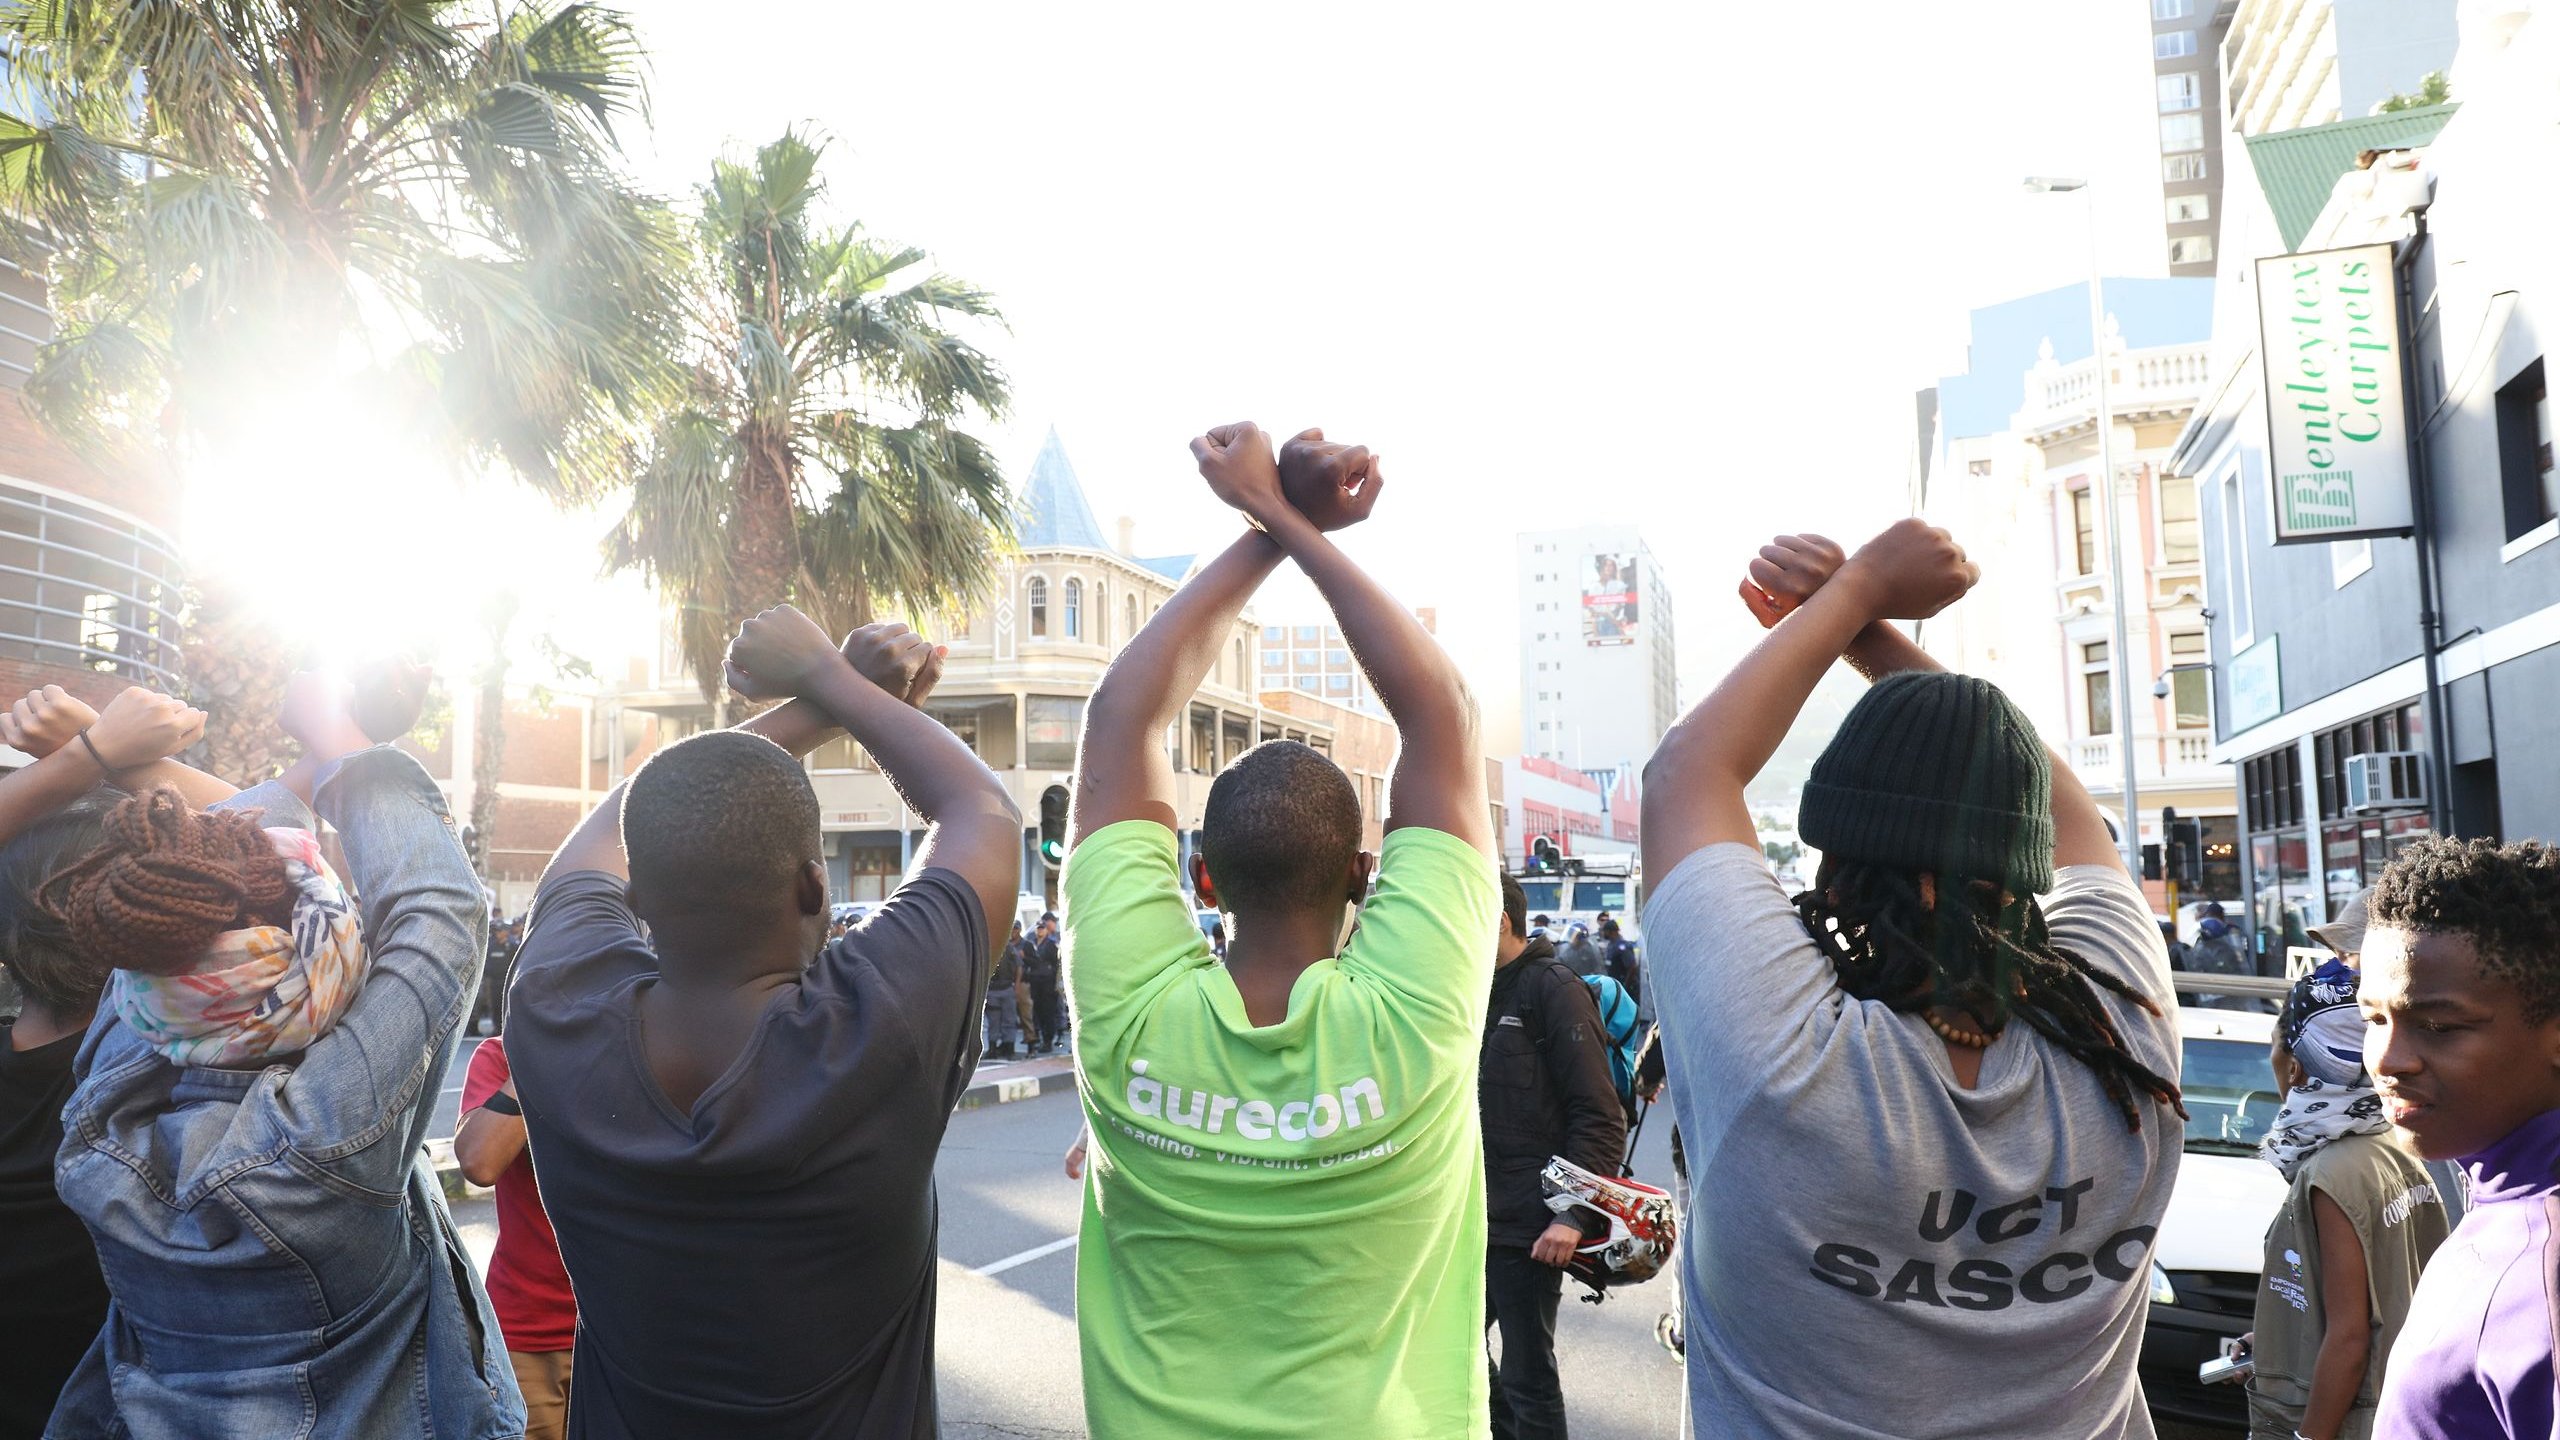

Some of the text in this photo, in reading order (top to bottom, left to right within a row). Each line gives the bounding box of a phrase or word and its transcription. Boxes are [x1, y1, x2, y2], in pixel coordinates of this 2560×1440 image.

[2338, 261, 2390, 443] Carpets
[2284, 261, 2356, 530] Bentleytex
[1126, 1059, 1385, 1142] aurecon
[1918, 1176, 2094, 1244] UCT
[1808, 1225, 2158, 1311] SASCO
